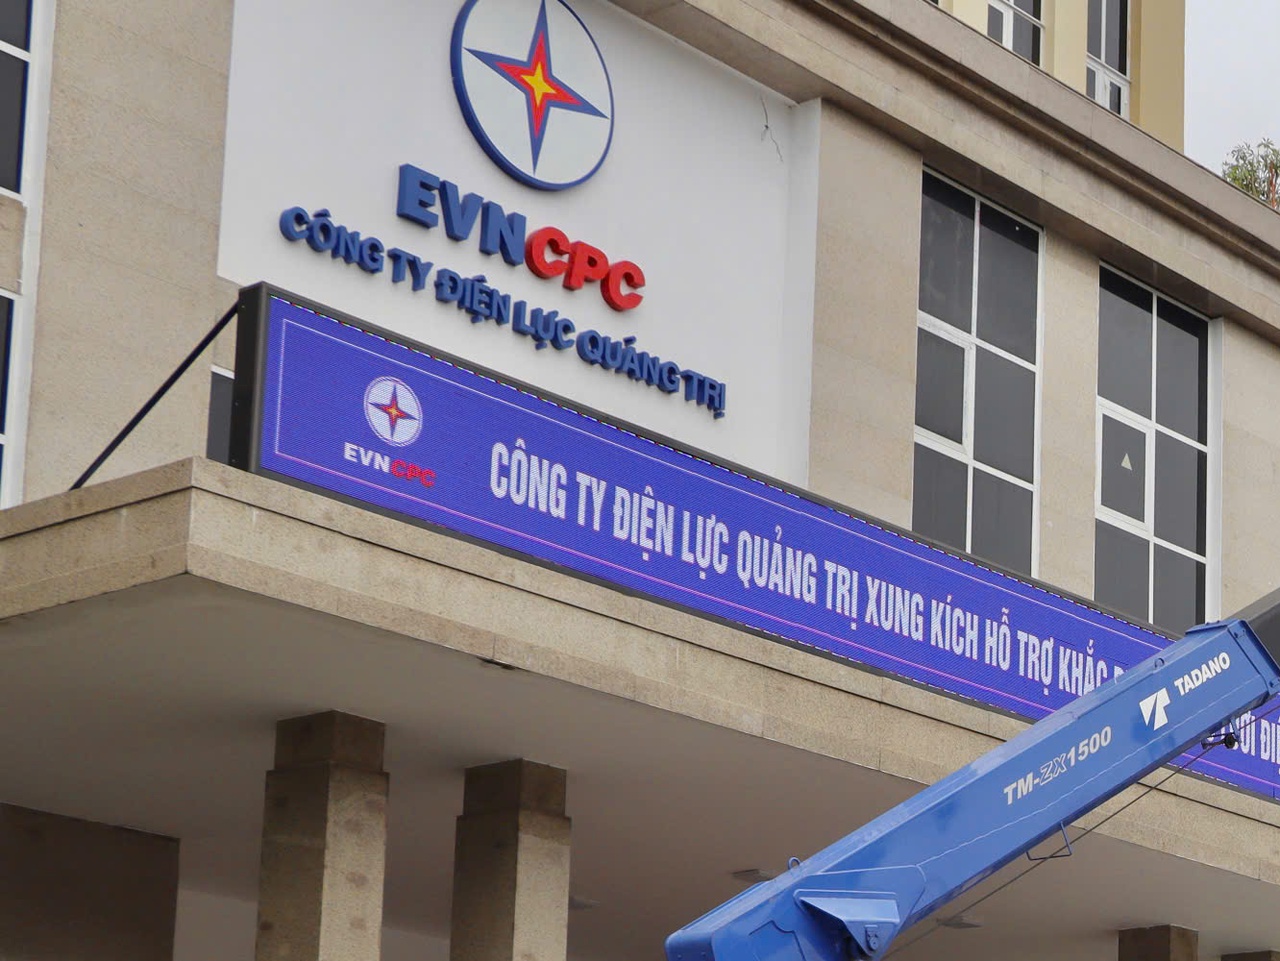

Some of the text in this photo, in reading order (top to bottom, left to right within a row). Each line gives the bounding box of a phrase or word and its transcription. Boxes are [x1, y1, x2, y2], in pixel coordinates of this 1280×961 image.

[396, 163, 646, 312] EVNCPC
[279, 206, 384, 274] CÔNG
[387, 248, 434, 292] TY
[434, 268, 510, 326] ĐIỆN
[512, 300, 575, 350] LỰC
[681, 368, 726, 419] TRỊ
[343, 441, 437, 488] EVNCPC
[490, 437, 567, 520] CÔNG
[576, 471, 607, 532] TY
[612, 485, 675, 562] ĐIỆN
[681, 510, 730, 580] LỰC
[737, 525, 818, 605] QUẢNG
[824, 559, 859, 631] TRỊ
[865, 575, 925, 642] XUNG
[930, 594, 979, 661] KÍCH
[984, 607, 1012, 672] HỖ
[1016, 629, 1055, 696] TRỢ
[1173, 651, 1231, 696] TADANO
[1003, 725, 1113, 805] TM-ZX1500
